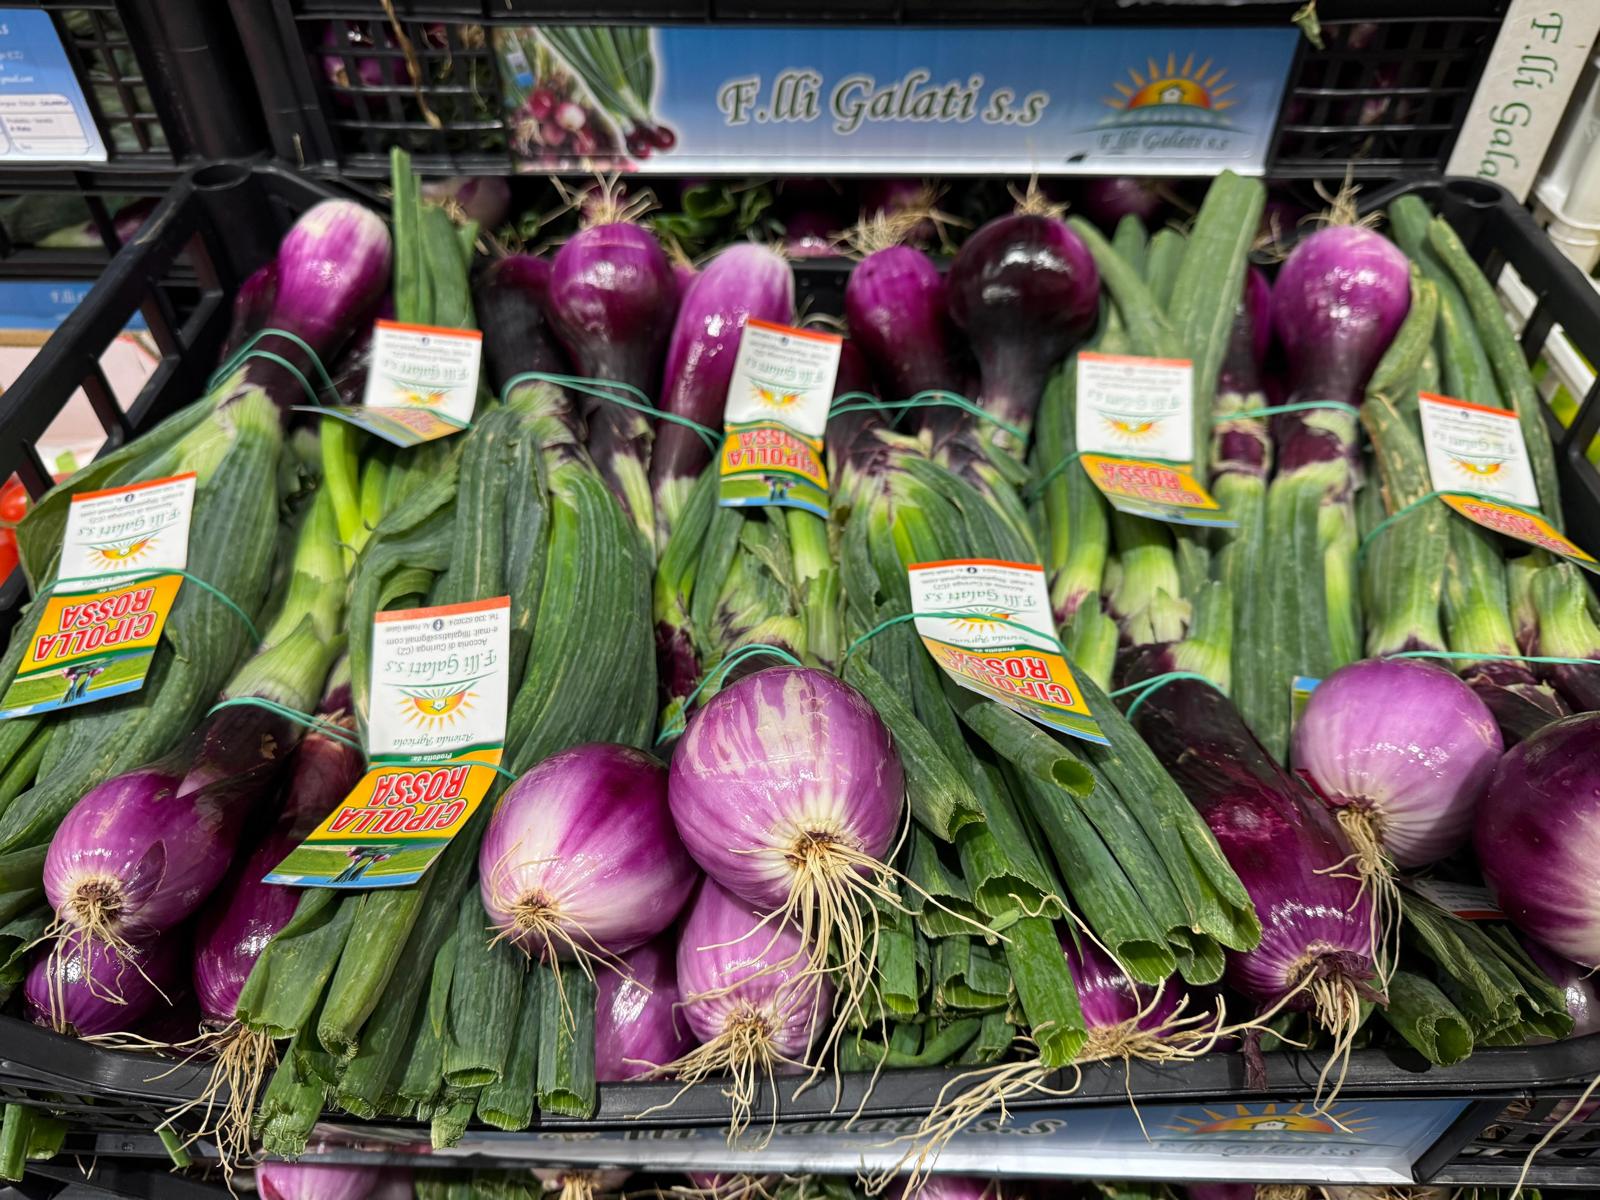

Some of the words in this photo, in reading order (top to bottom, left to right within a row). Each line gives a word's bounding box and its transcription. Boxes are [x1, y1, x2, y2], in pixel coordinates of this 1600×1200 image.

[1512, 12, 1563, 89] F.lli
[718, 69, 822, 126] F.lli
[829, 68, 984, 135] Galati
[981, 89, 1049, 126] s.s
[1477, 102, 1533, 178] Gala
[99, 516, 145, 538] Galati
[949, 588, 999, 604] Galati
[59, 587, 154, 631] ROSSA
[33, 612, 157, 662] CIPOLLA
[416, 643, 447, 653] Curinga
[449, 640, 456, 648] di
[458, 638, 487, 647] Acconia
[397, 647, 414, 656] (CZ)
[464, 649, 497, 676] F.lli
[385, 660, 405, 672] s.s
[407, 653, 459, 681] Galati
[944, 648, 1052, 682] ROSSA
[393, 734, 434, 747] Agricola
[436, 732, 474, 745] Azienda
[426, 752, 453, 762] Prodotta
[369, 764, 472, 807] ROSSA
[328, 799, 467, 834] CIPOLLA
